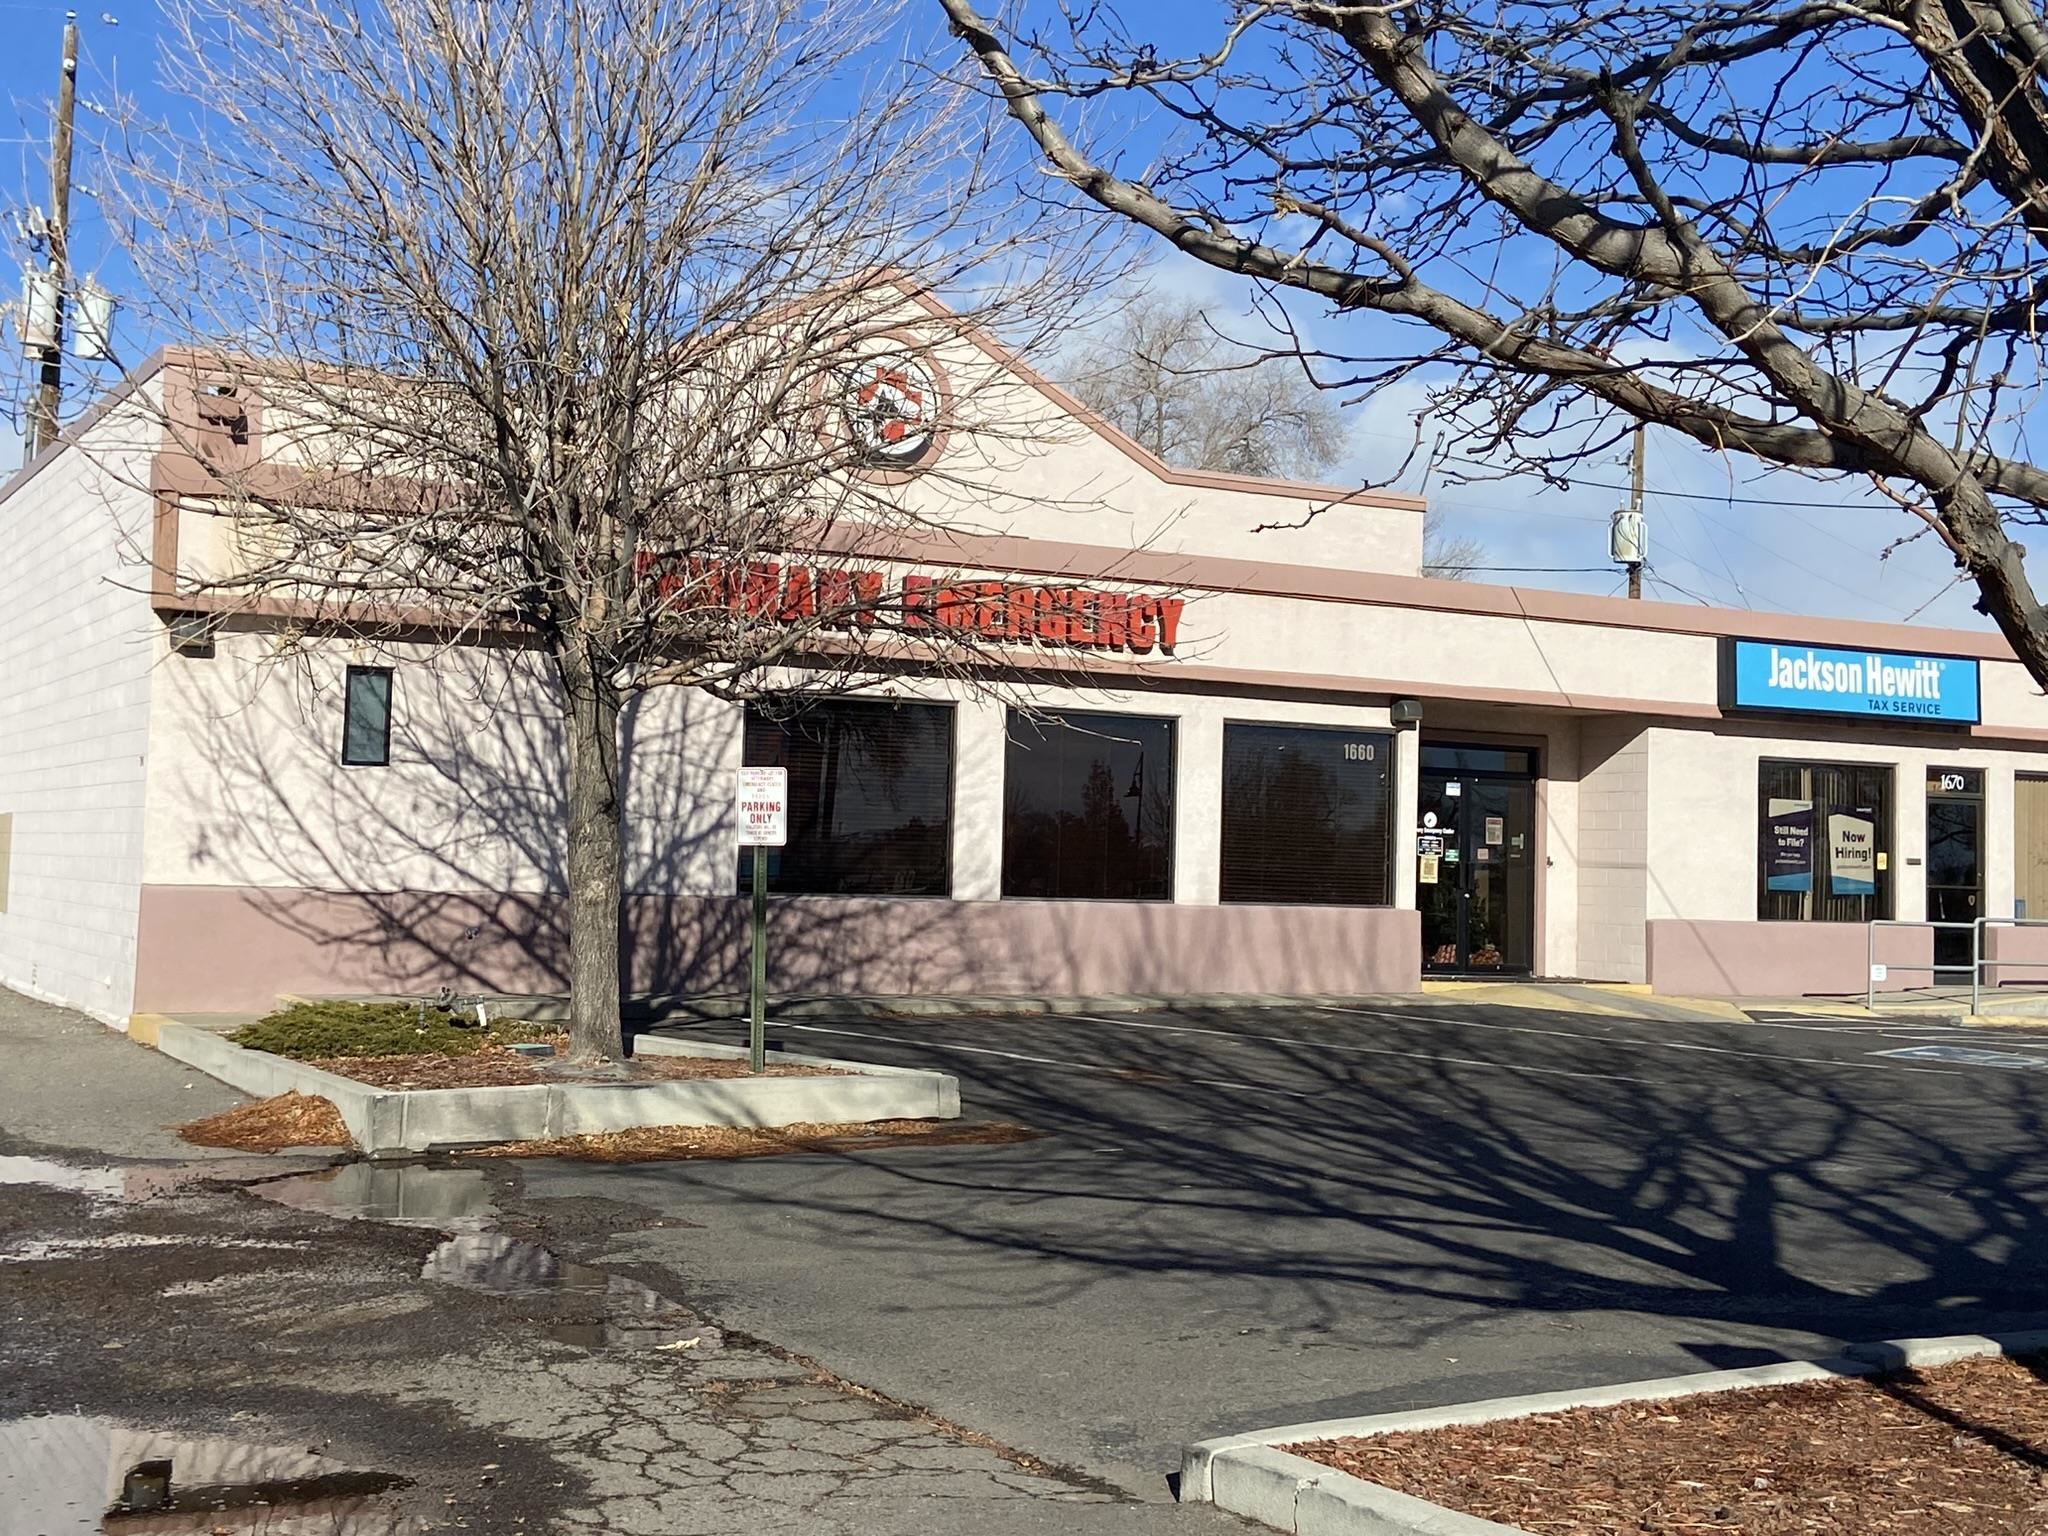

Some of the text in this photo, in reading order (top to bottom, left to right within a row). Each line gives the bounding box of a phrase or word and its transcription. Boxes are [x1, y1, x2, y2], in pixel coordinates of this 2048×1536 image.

[903, 575, 1185, 649] EMERGENCY
[1768, 647, 1941, 700] Jackson Hewitt
[1867, 699, 1942, 715] TAX SERVICE
[1343, 743, 1375, 761] 1660
[1940, 774, 1965, 790] 1670
[741, 801, 782, 812] PARKING
[749, 813, 773, 824] ONLY
[1774, 825, 1809, 836] Still Need
[1842, 831, 1866, 843] Now
[1778, 838, 1805, 848] to File?
[1834, 847, 1872, 862] Hiring!
